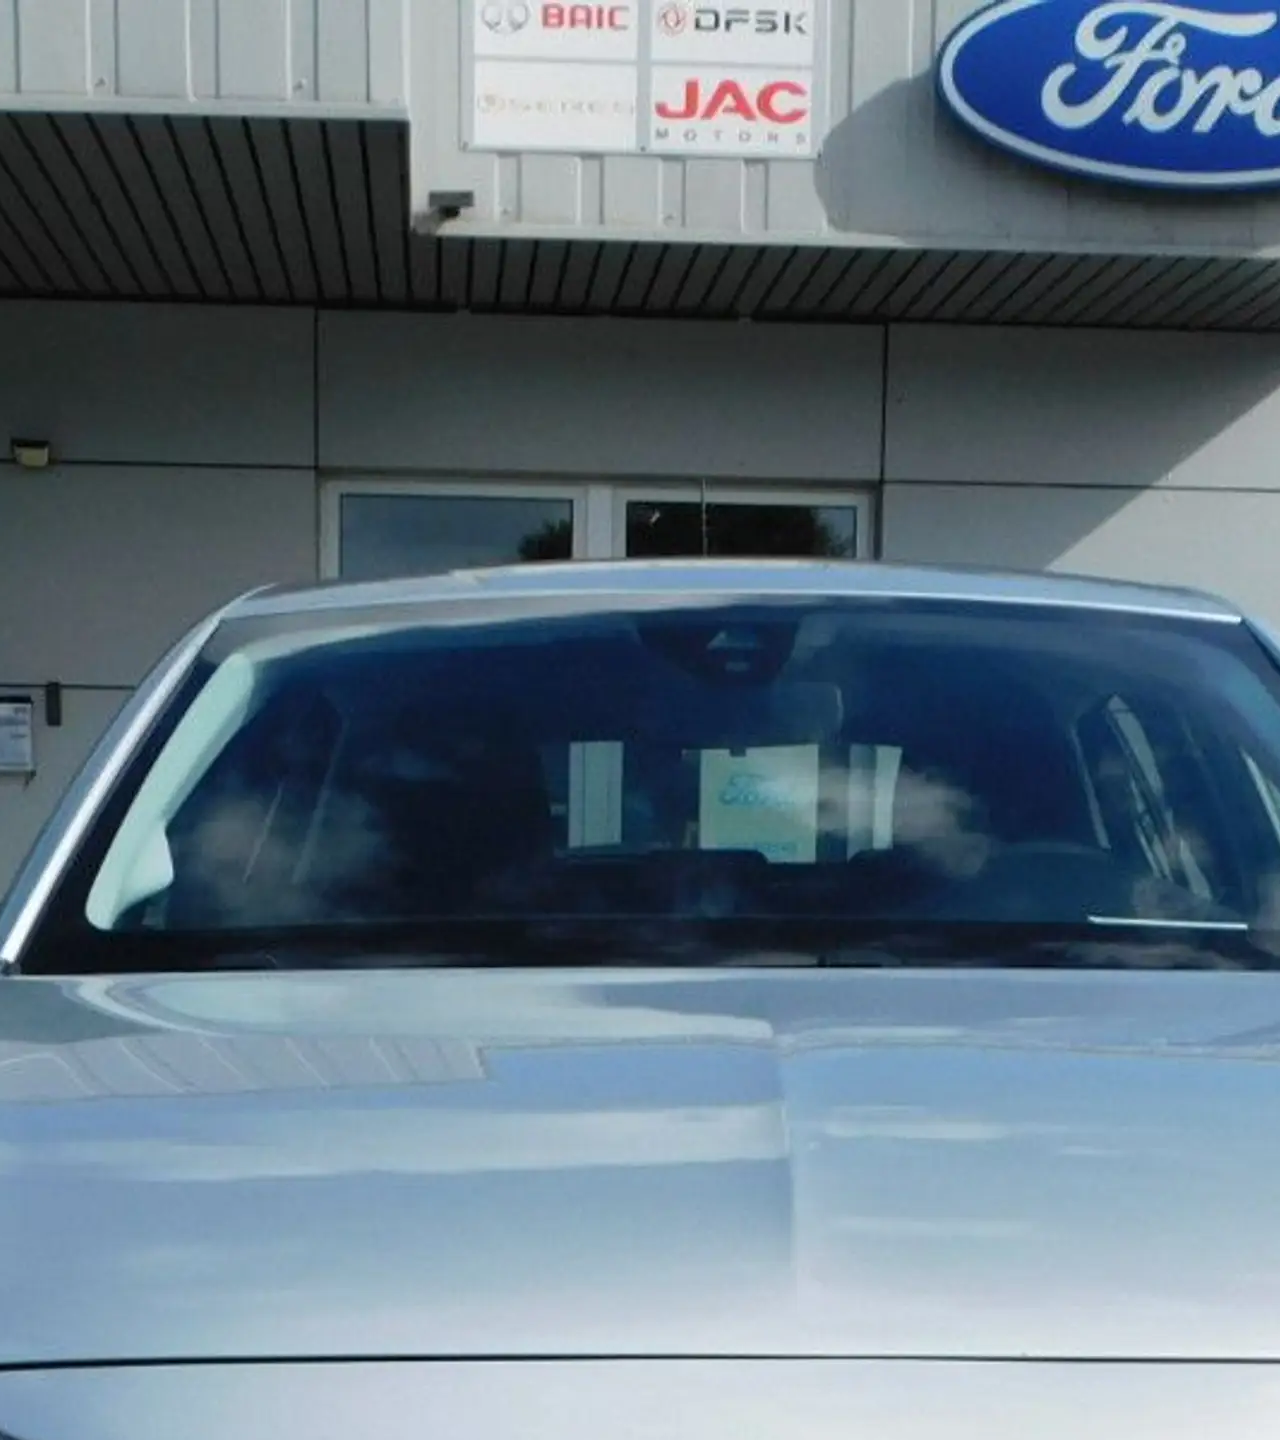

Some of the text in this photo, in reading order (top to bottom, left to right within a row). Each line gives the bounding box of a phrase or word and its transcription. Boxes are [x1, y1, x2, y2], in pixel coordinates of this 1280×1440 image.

[540, 4, 631, 32] BAIC
[693, 8, 808, 36] DFSK
[653, 77, 808, 125] JAC
[654, 128, 808, 146] MOTORS
